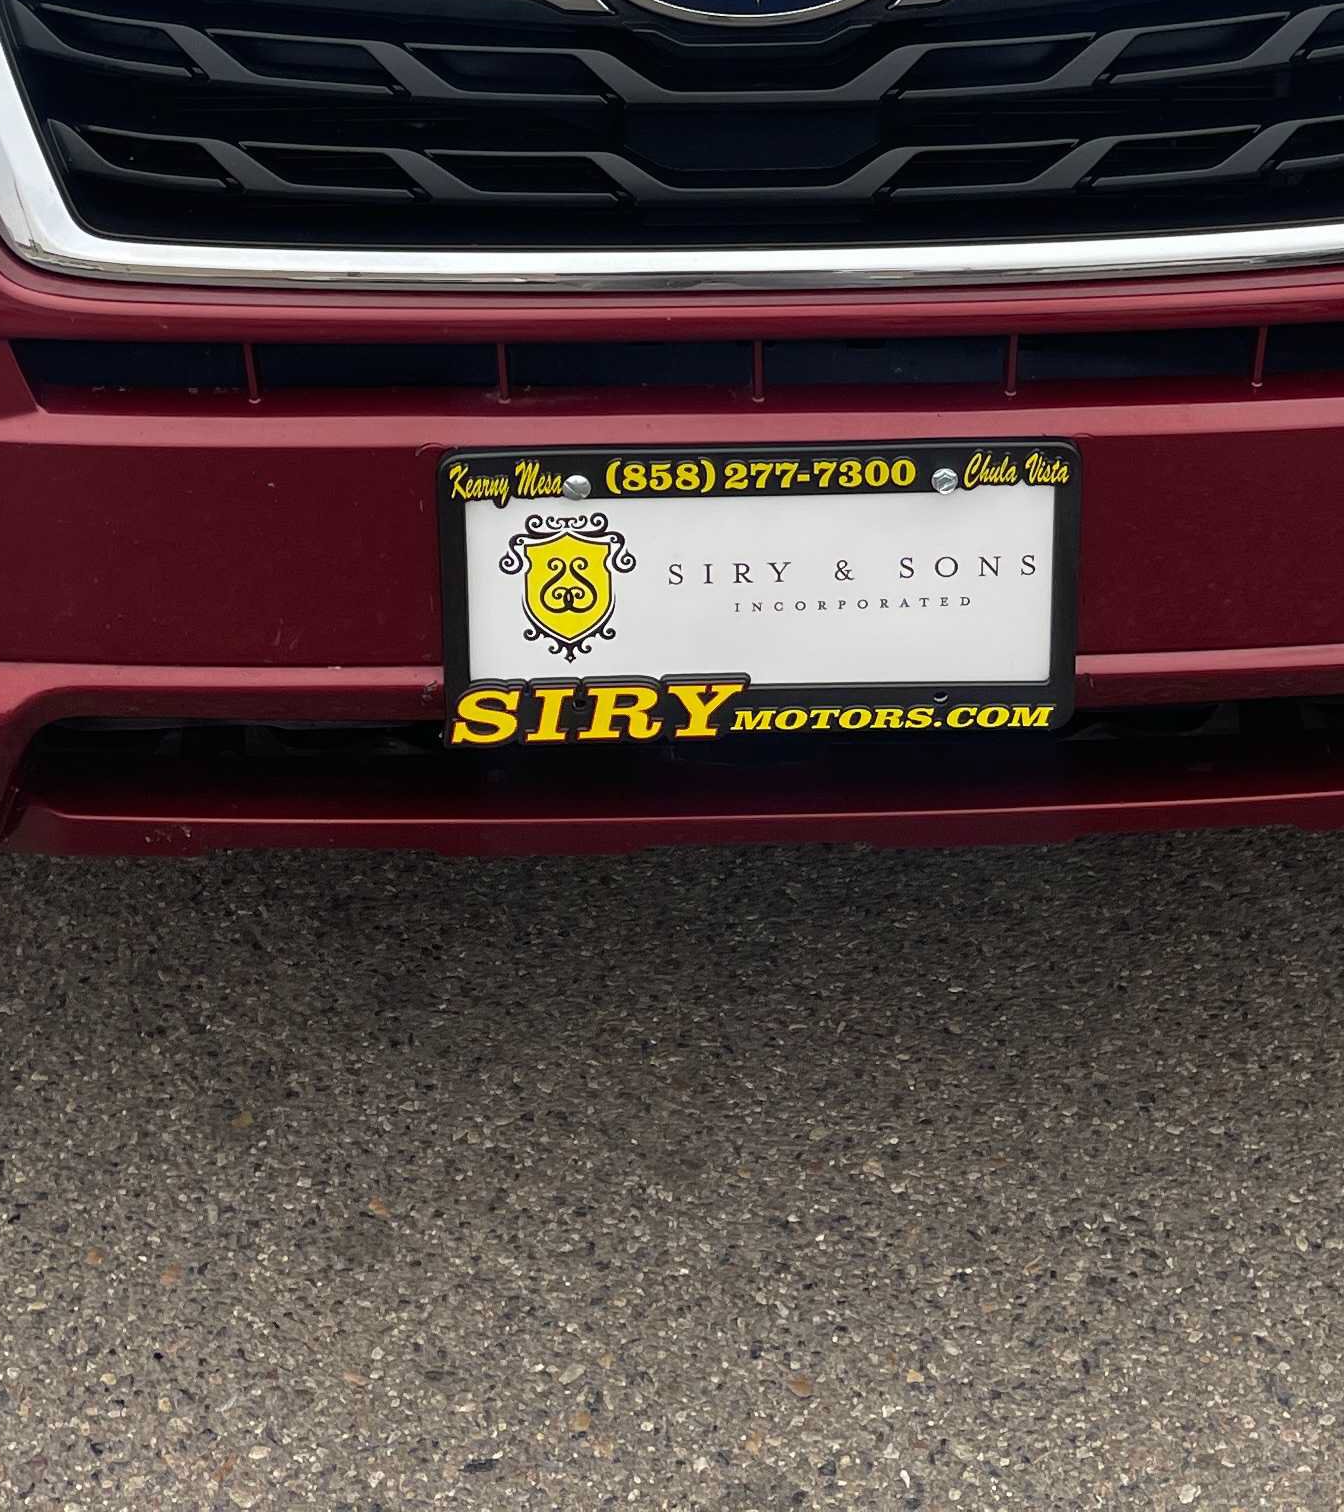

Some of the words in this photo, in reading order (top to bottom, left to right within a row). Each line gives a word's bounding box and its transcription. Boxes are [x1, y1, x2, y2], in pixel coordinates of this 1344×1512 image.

[449, 465, 511, 506] Kearny
[514, 462, 564, 498] Mesa
[605, 461, 716, 493] (858)
[723, 458, 918, 490] 277-7300
[963, 452, 1018, 485] Chula
[1024, 452, 1070, 485] Vista
[667, 560, 793, 587] SIRY
[833, 559, 855, 582] &
[898, 553, 1039, 580] SONS
[733, 595, 973, 614] INCORPORATED
[451, 682, 744, 745] SIRY
[730, 704, 1056, 732] MOTORS.COM
